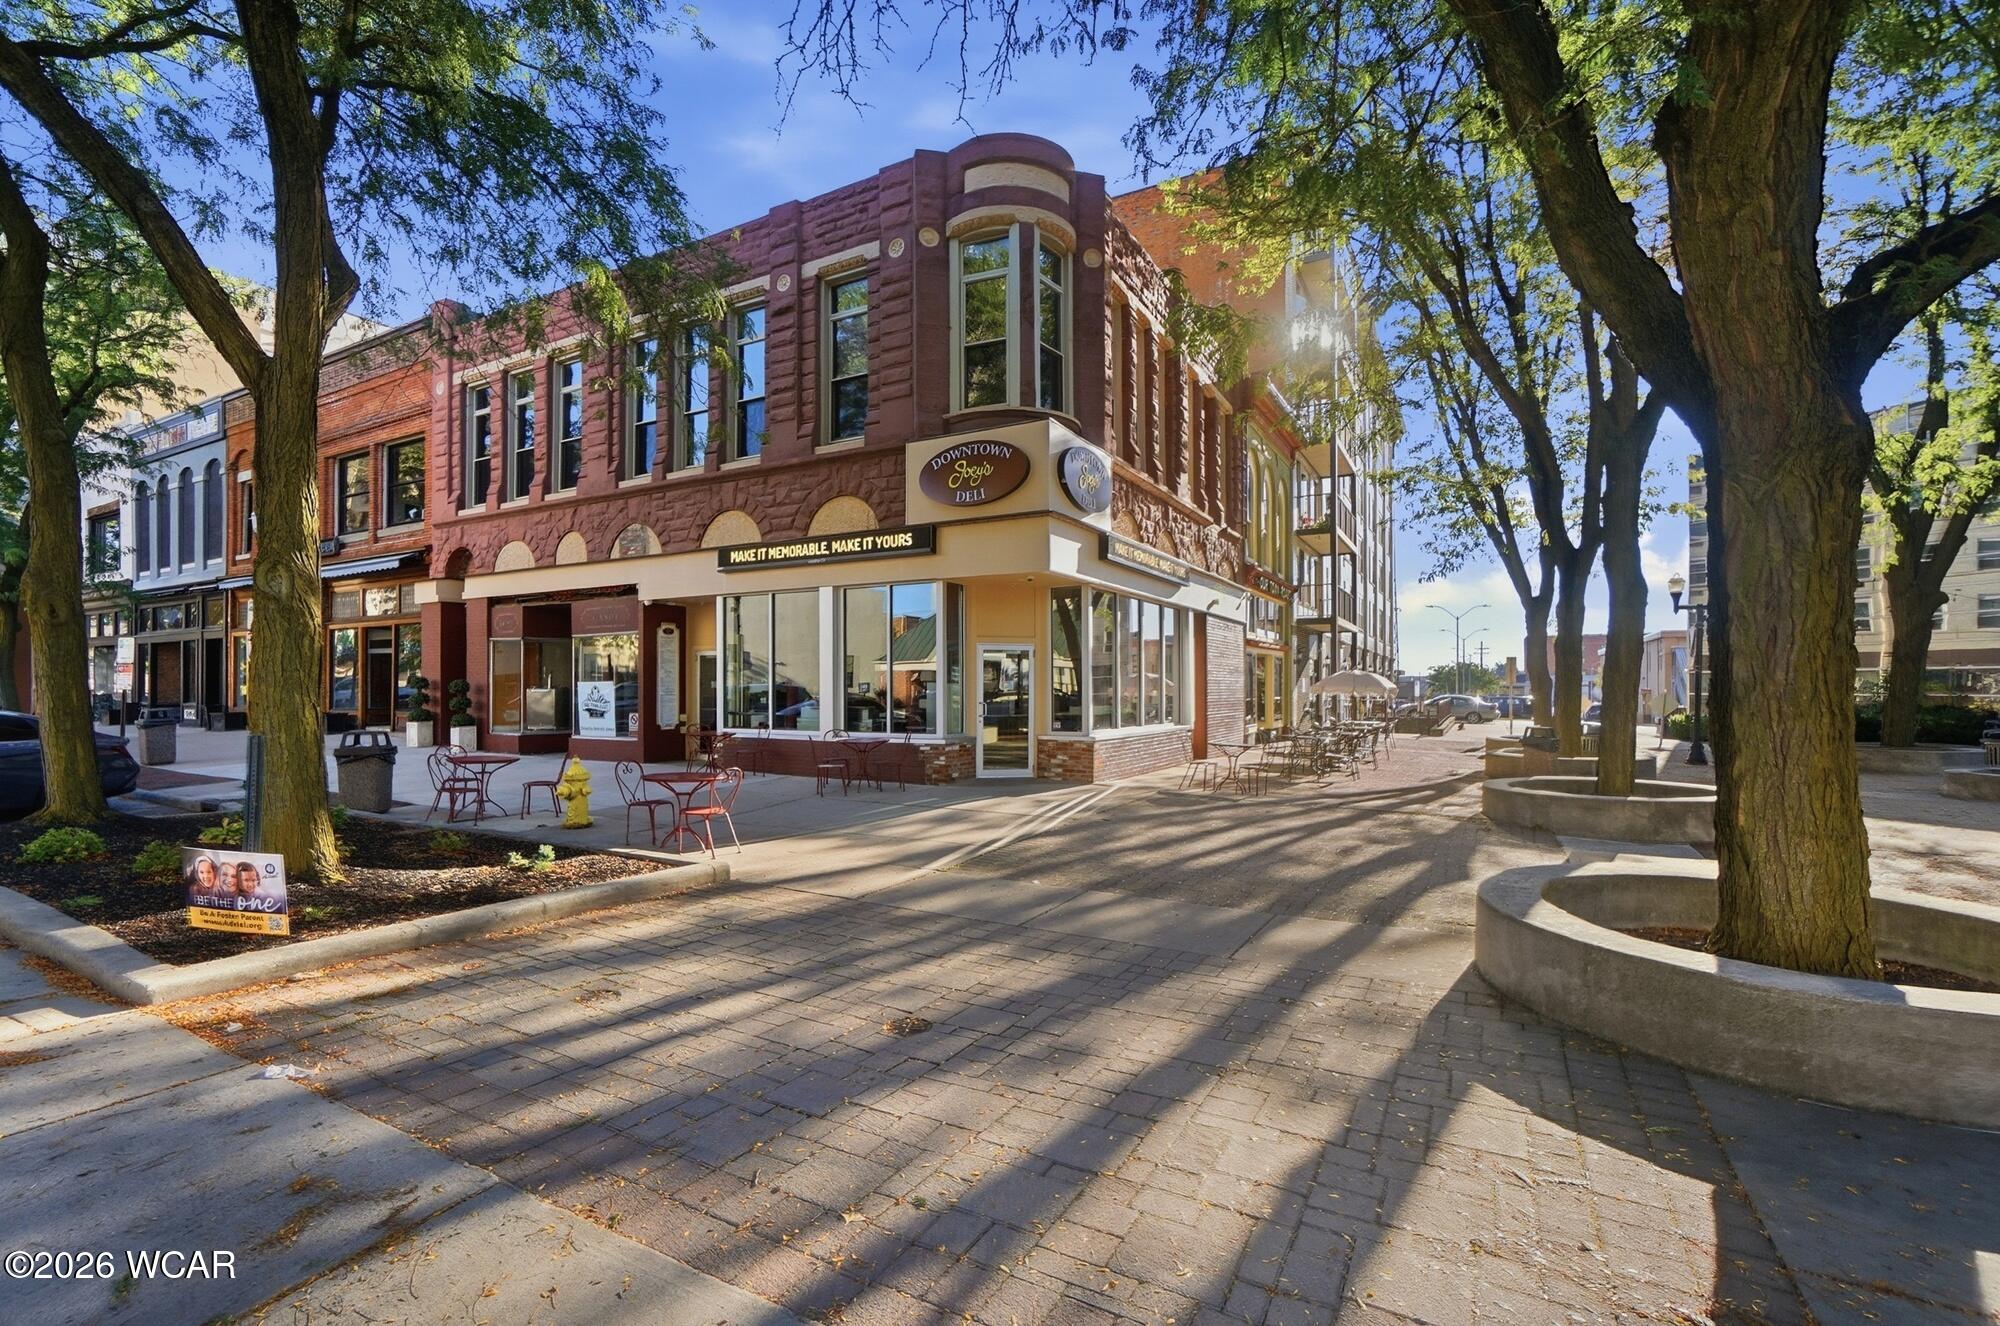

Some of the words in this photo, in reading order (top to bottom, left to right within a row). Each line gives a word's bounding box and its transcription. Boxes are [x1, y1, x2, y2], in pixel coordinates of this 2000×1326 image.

[930, 443, 1012, 471] DOWNTOWN
[948, 460, 994, 489] Joey's
[955, 488, 986, 502] DELI
[730, 549, 756, 563] MAKE
[757, 548, 767, 561] IT
[832, 537, 861, 553] MAKE
[863, 536, 874, 551] IT
[875, 533, 913, 549] YOURS
[237, 896, 282, 912] one
